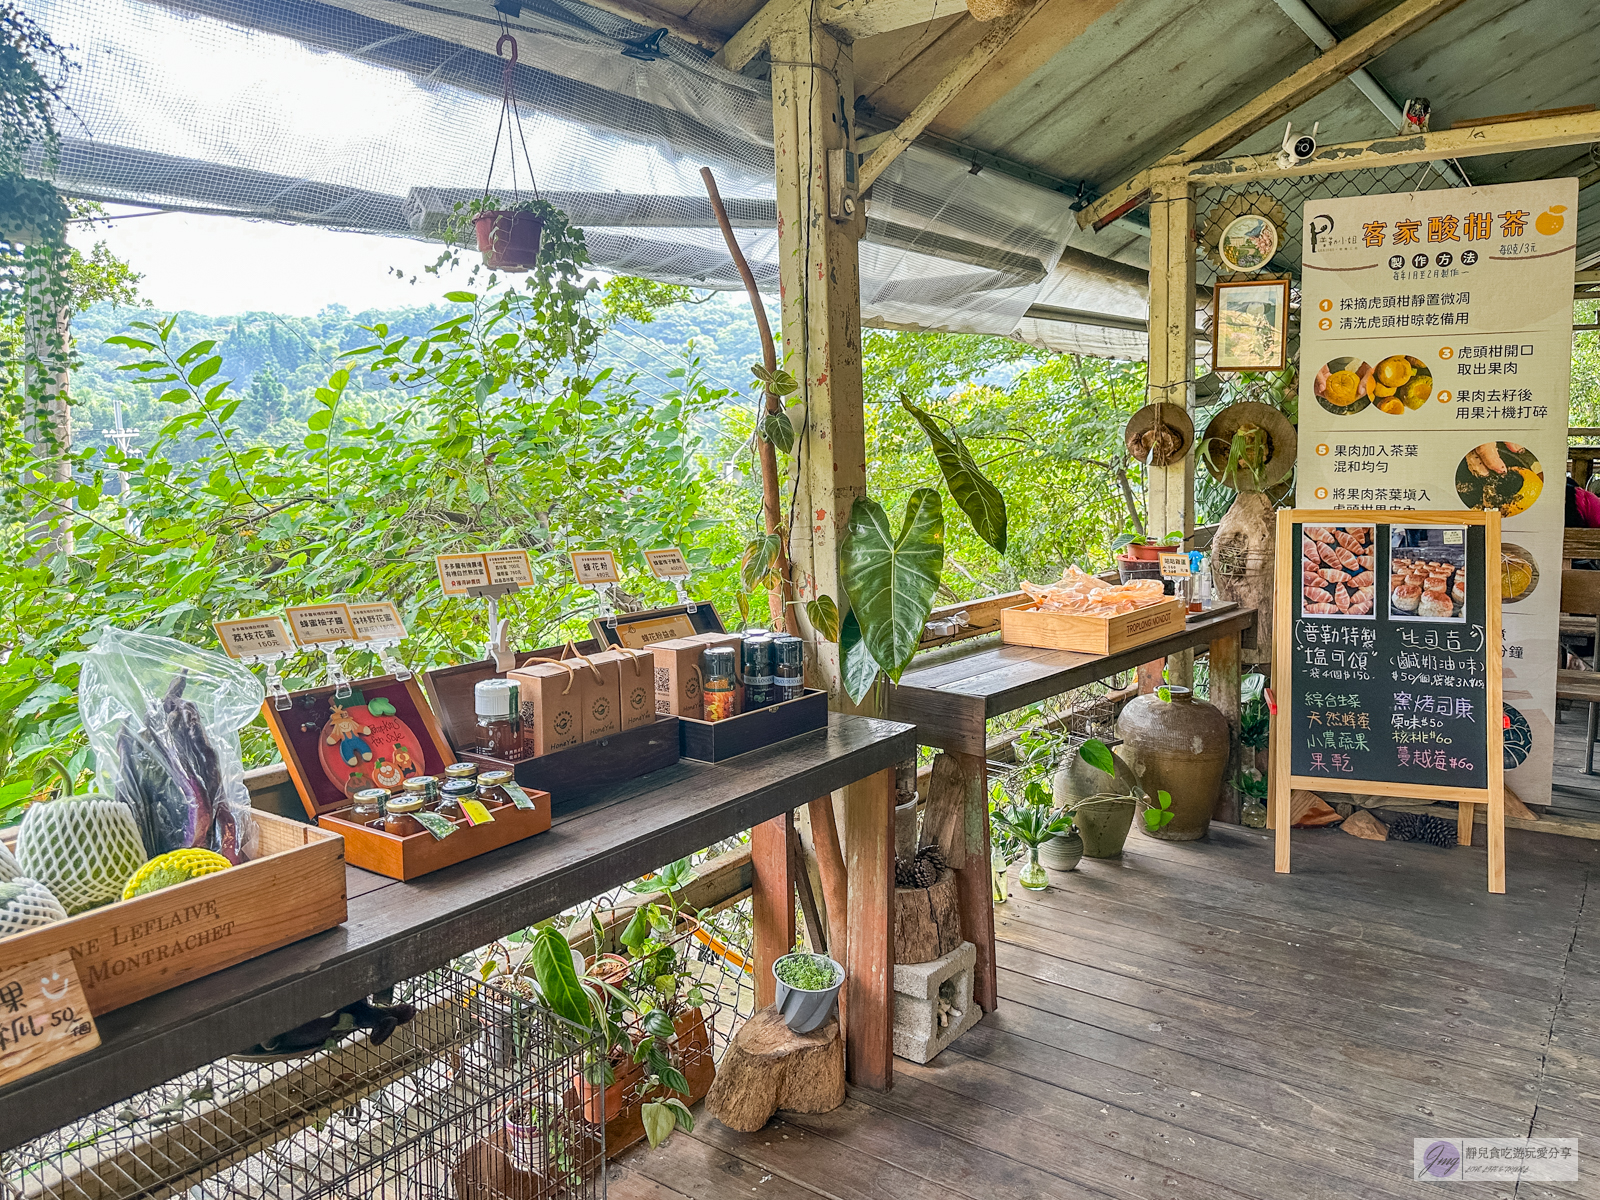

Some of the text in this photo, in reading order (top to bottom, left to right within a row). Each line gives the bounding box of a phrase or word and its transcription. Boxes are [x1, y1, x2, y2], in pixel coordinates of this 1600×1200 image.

[1362, 210, 1530, 248] 客家酸柑茶
[1389, 250, 1478, 270] 製作方法
[1339, 312, 1469, 330] 清洗虎頭柑晾乾備用
[1457, 344, 1534, 359] 虎頭柑開口
[1457, 362, 1518, 376] 取出果肉
[1457, 388, 1533, 403] 果肉去籽後
[1456, 405, 1548, 420] 用果汁機打碎
[1334, 444, 1419, 457] 果肉加入茶葉
[1333, 460, 1389, 474] 混和均勻
[583, 562, 608, 571] 蜂花粉
[232, 630, 276, 642] 荔枝花蜜
[1303, 622, 1376, 649] 普勒特製
[257, 640, 280, 648] 150元
[1304, 692, 1362, 708] 綜合生菜
[1393, 692, 1475, 723] 窯烤司康
[1307, 711, 1371, 730] 天然蜂蜜
[1307, 731, 1370, 751] 小農蔬果
[1309, 753, 1354, 772] 果乾
